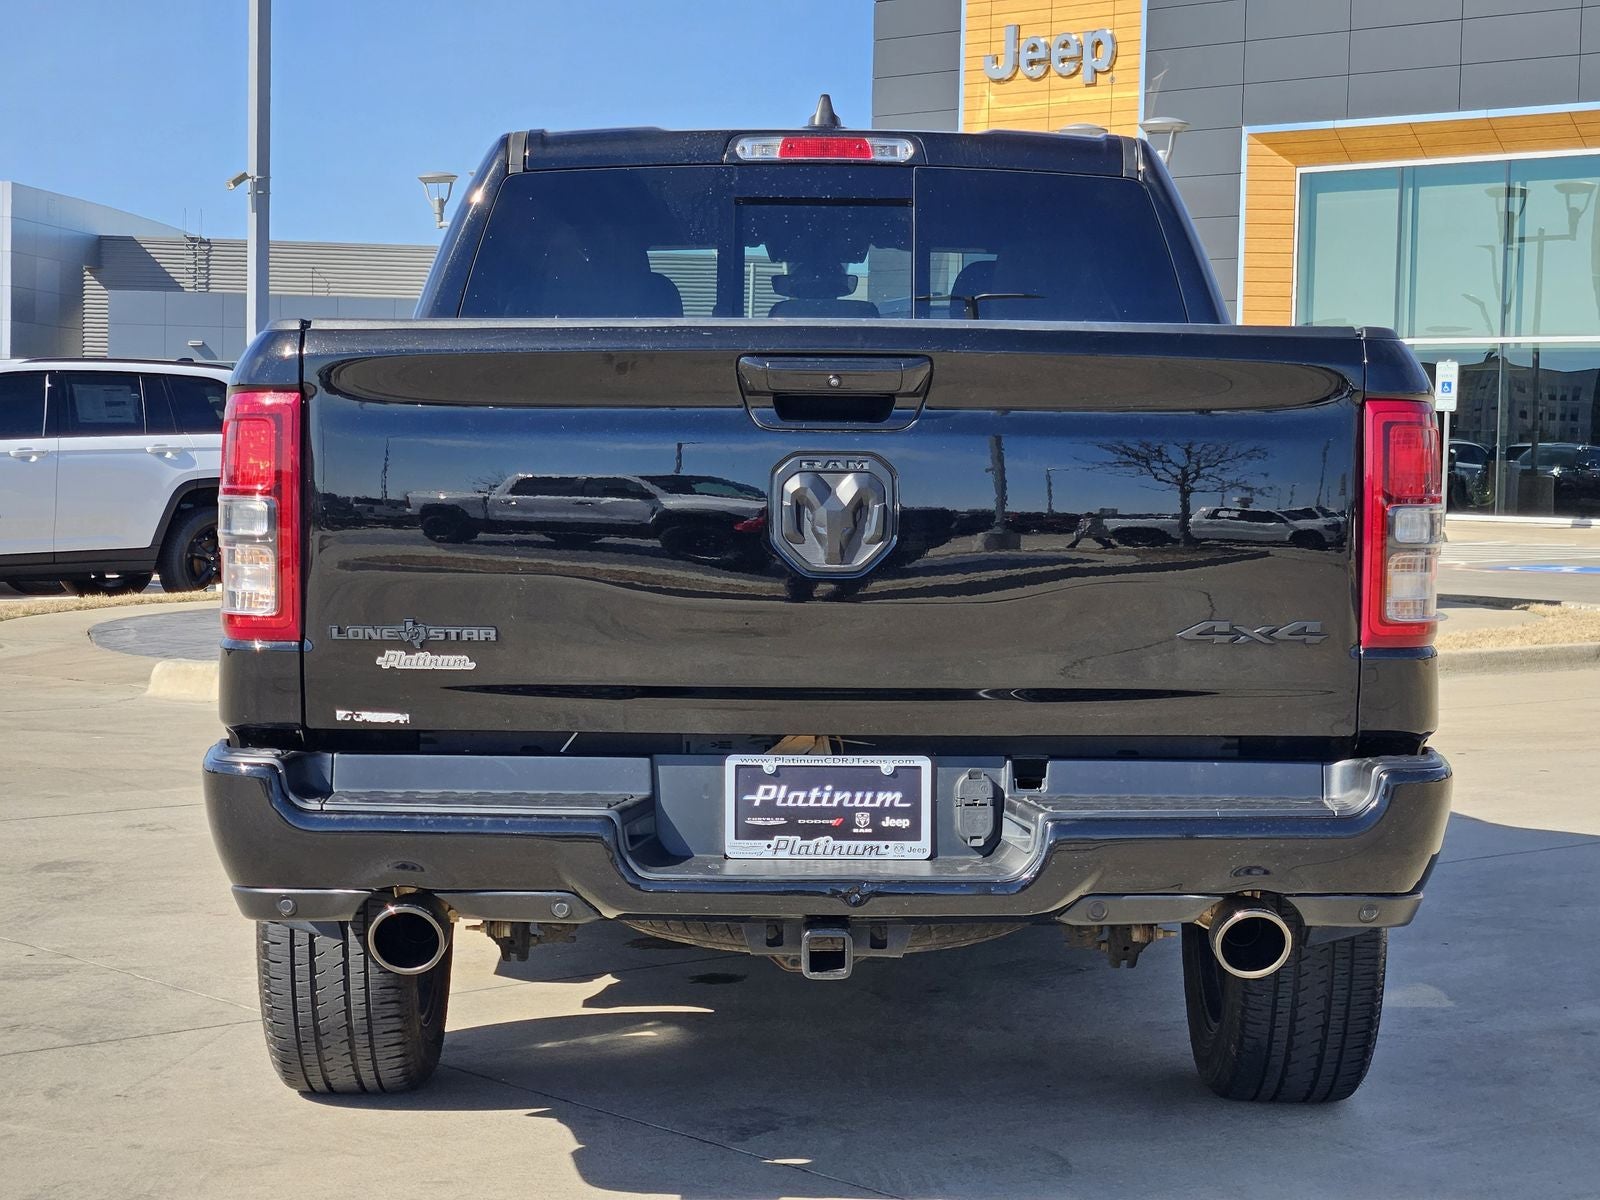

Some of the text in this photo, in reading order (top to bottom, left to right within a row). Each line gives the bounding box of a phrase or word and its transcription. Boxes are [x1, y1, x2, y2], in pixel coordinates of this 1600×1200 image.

[983, 24, 1118, 87] Jeep
[799, 459, 870, 471] RAM
[330, 625, 498, 641] LONE STAR
[376, 650, 477, 670] Platinum
[740, 756, 915, 765] www.PlatinumCDRJTexas.com
[742, 784, 912, 808] Platinum
[881, 816, 910, 829] Jeep
[771, 839, 888, 856] Platinum
